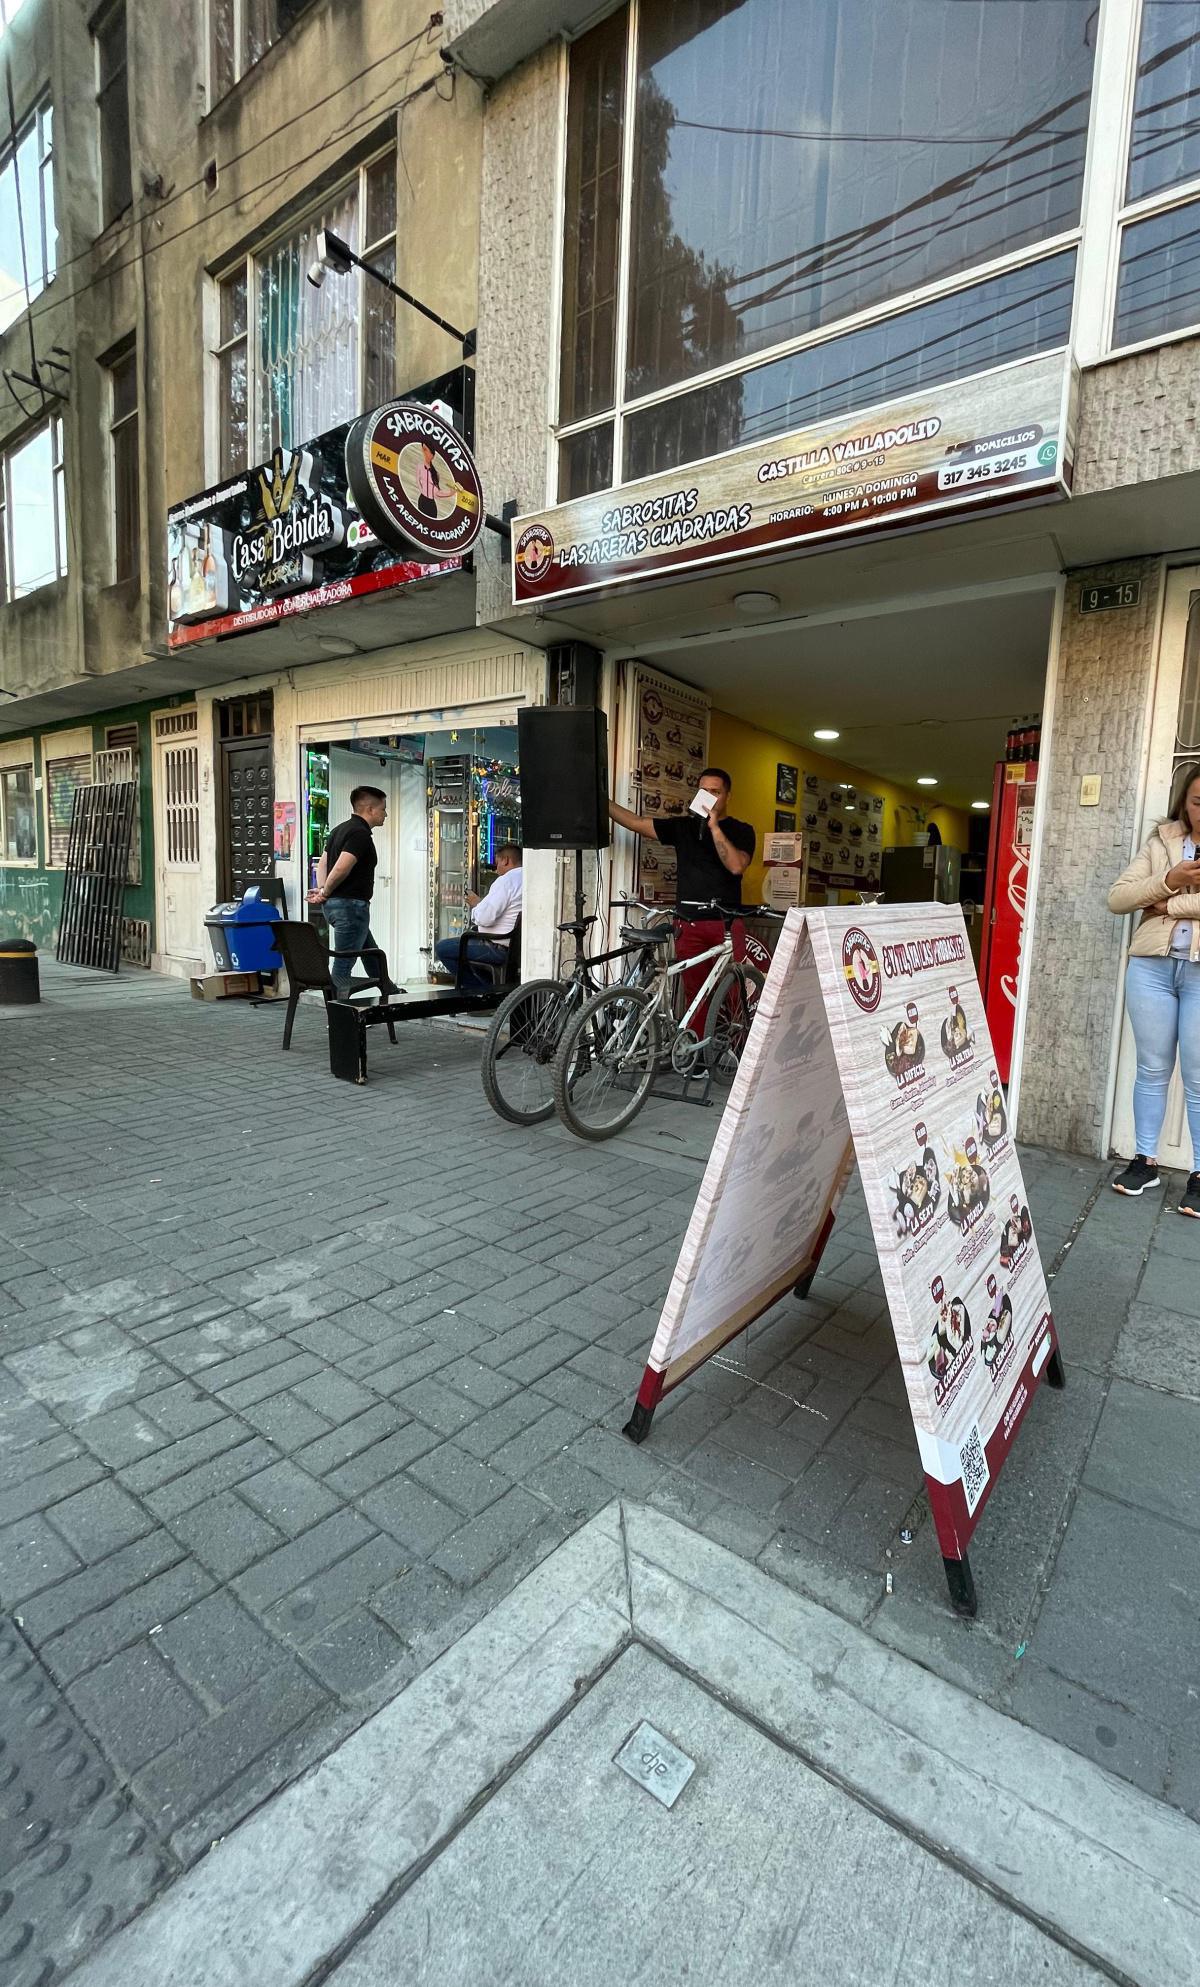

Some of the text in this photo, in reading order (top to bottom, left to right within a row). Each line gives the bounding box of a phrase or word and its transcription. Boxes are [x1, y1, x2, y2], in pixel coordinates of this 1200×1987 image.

[386, 411, 469, 472] SABROSITAS
[758, 417, 941, 482] CASTILLA VALLADOLID
[974, 430, 1035, 454] DOMICILIOS
[802, 468, 835, 483] Carrera
[860, 459, 867, 469] 9
[873, 455, 885, 467] 15
[943, 454, 1027, 485] 317 345 3245
[822, 486, 917, 517] 4:00 PM A 10:00 PM
[823, 472, 918, 504] LUNES A DOMINGO
[382, 476, 398, 501] LAS
[396, 503, 429, 535] AREPAS
[430, 516, 471, 542] CUADRADAS
[602, 488, 698, 533] SABROSITAS
[769, 505, 814, 523] HORARIO:
[232, 535, 266, 580] Casa
[272, 499, 331, 564] Bebida
[560, 544, 588, 568] LAS
[589, 530, 648, 561] AREPAS
[651, 503, 751, 547] CUADRADAS
[1090, 591, 1098, 608] 9
[1115, 585, 1133, 604] 15
[233, 606, 278, 626] DISTRIBUIDORA
[278, 604, 284, 614] Y
[896, 1074, 905, 1087] LA
[910, 1202, 934, 1235] LA SEXY
[960, 1219, 968, 1235] LA
[935, 1382, 944, 1403] LA
